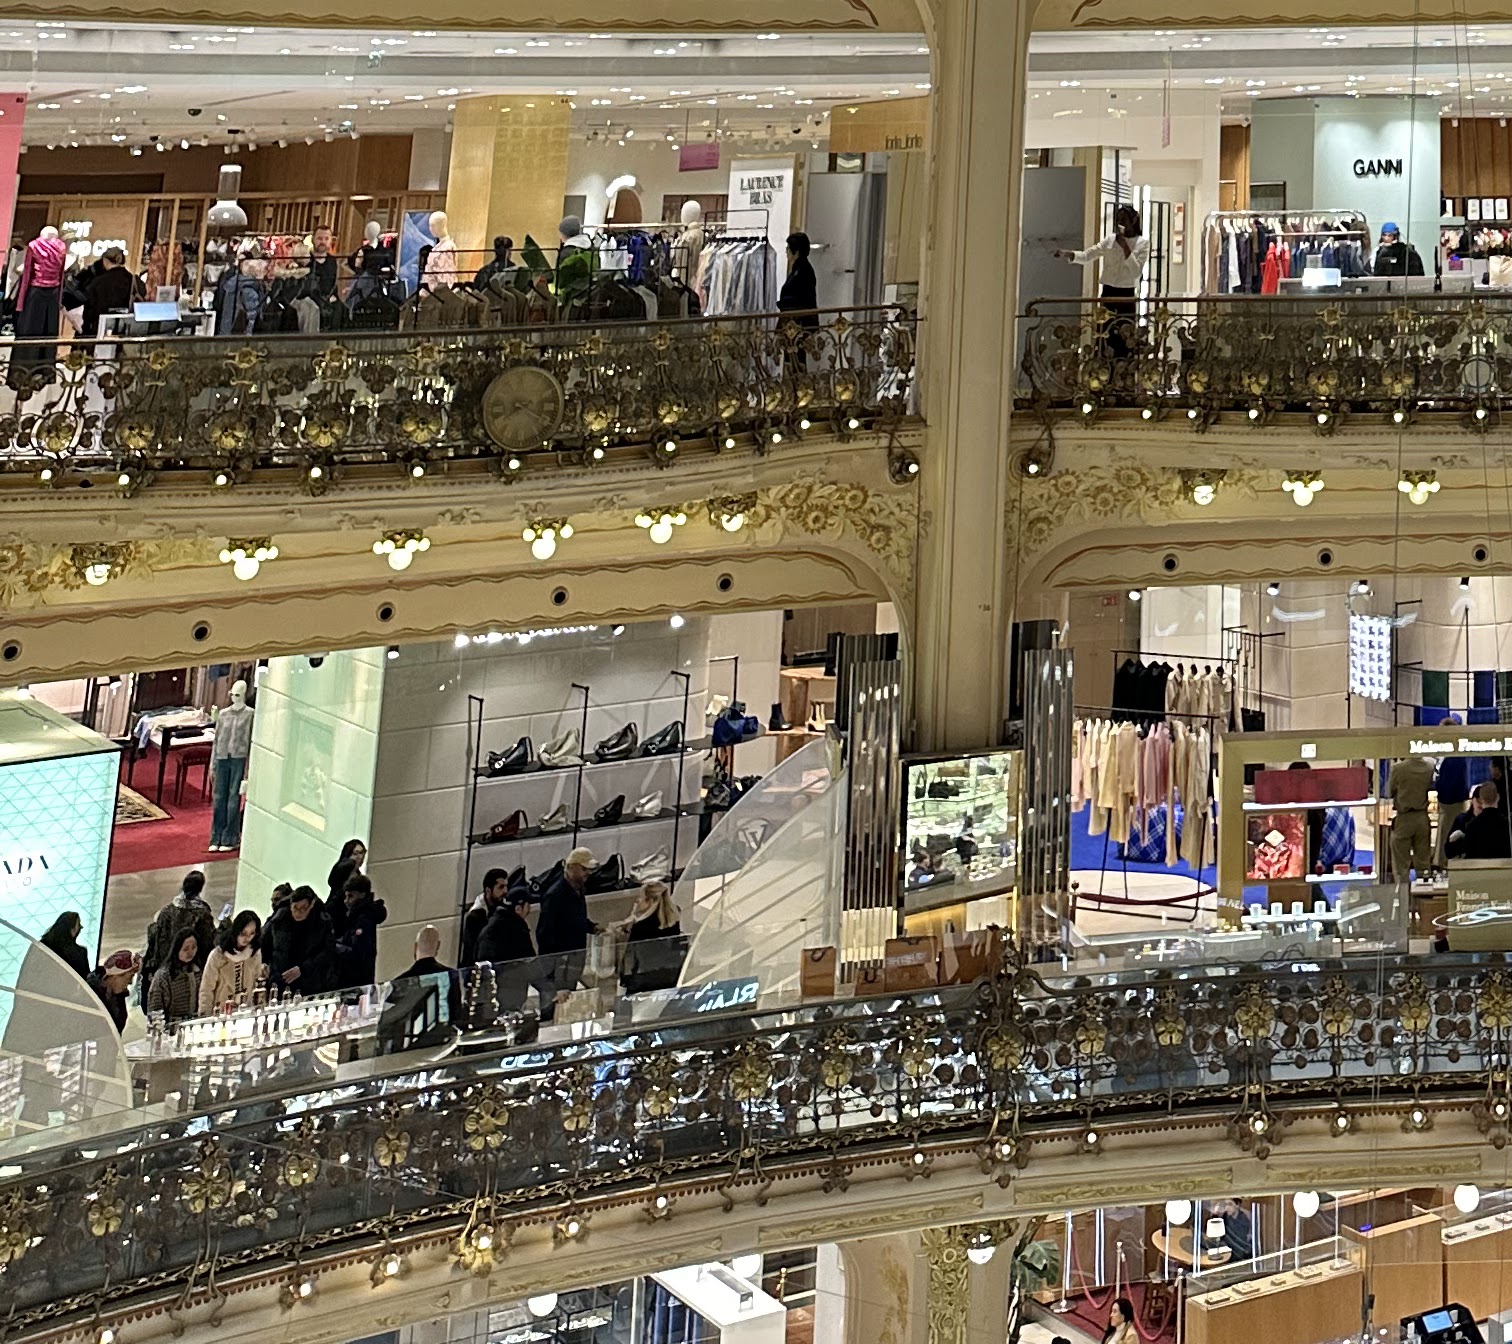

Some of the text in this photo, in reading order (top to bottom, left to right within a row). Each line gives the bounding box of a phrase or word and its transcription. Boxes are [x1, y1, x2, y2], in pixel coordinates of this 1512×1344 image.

[1353, 158, 1403, 177] GANNI
[749, 191, 773, 205] BRAS
[1409, 740, 1454, 754] Maison
[1458, 738, 1502, 752] Francis
[1456, 890, 1489, 900] Maison
